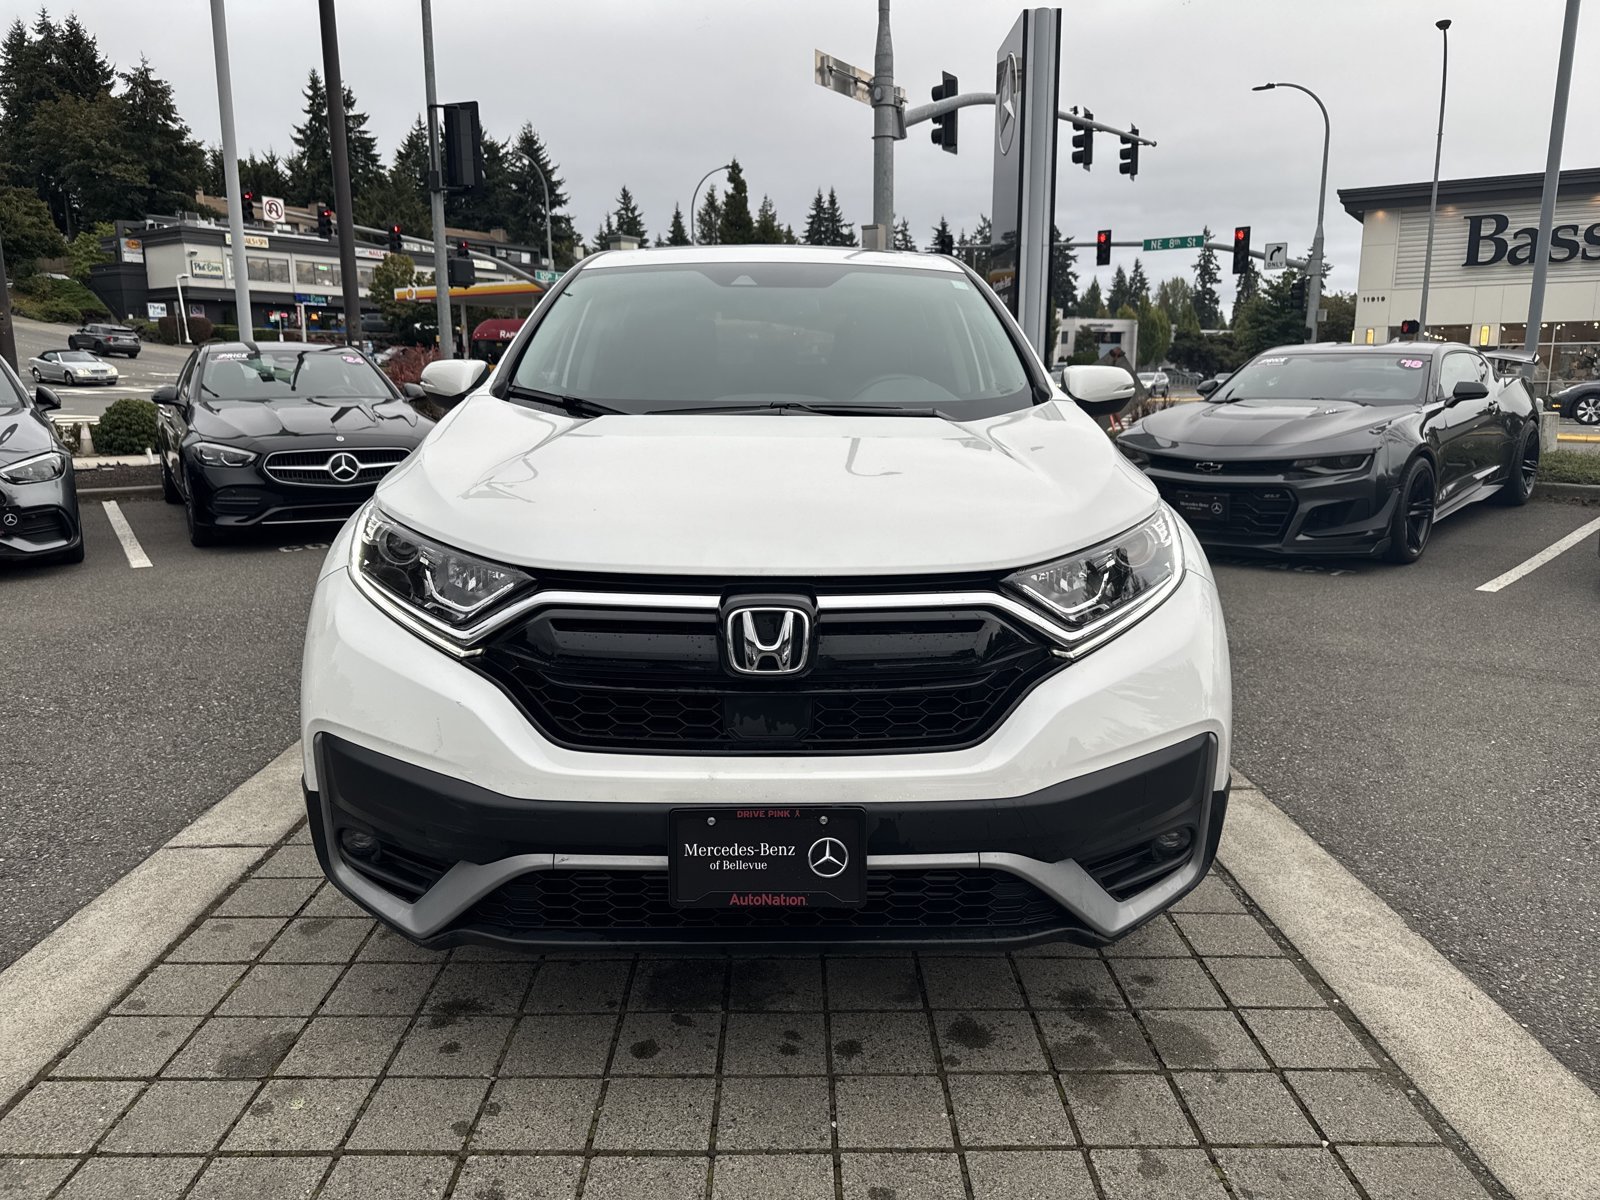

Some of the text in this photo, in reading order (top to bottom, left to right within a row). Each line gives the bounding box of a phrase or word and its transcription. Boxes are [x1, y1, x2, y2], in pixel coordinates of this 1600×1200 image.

[1150, 237, 1196, 250] NE 8th St
[736, 809, 791, 818] DRIVE PINK
[683, 842, 796, 857] Mercedes-Benz
[709, 860, 768, 870] of Bellevue
[729, 893, 806, 906] AutoNation
